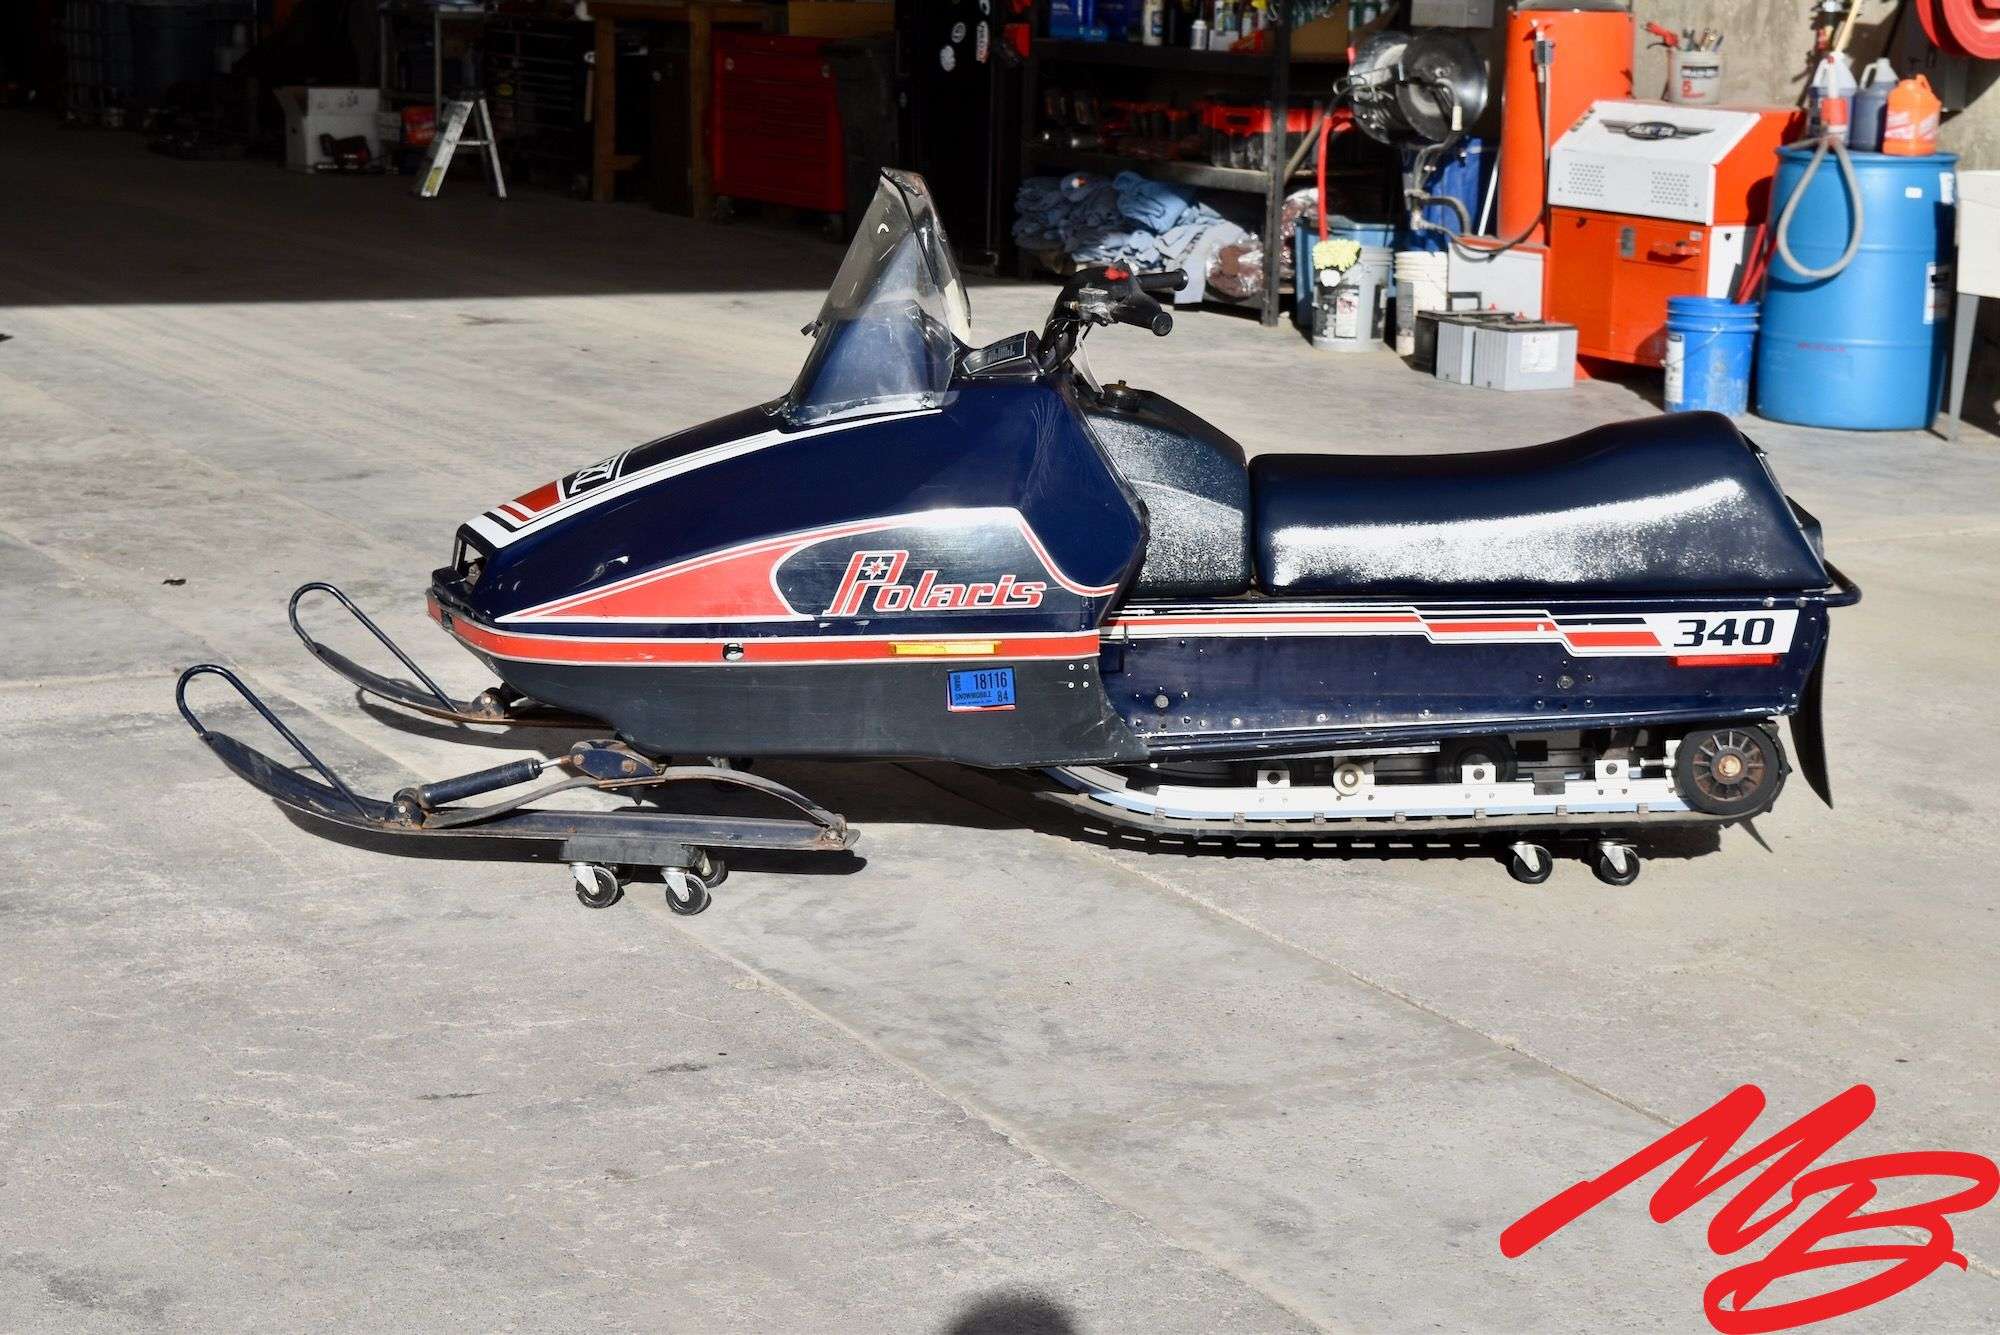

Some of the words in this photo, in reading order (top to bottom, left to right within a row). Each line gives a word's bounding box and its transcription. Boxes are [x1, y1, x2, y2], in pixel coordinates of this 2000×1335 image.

[821, 550, 1047, 617] Polaris
[1674, 617, 1775, 648] 340
[973, 671, 1008, 691] 18116
